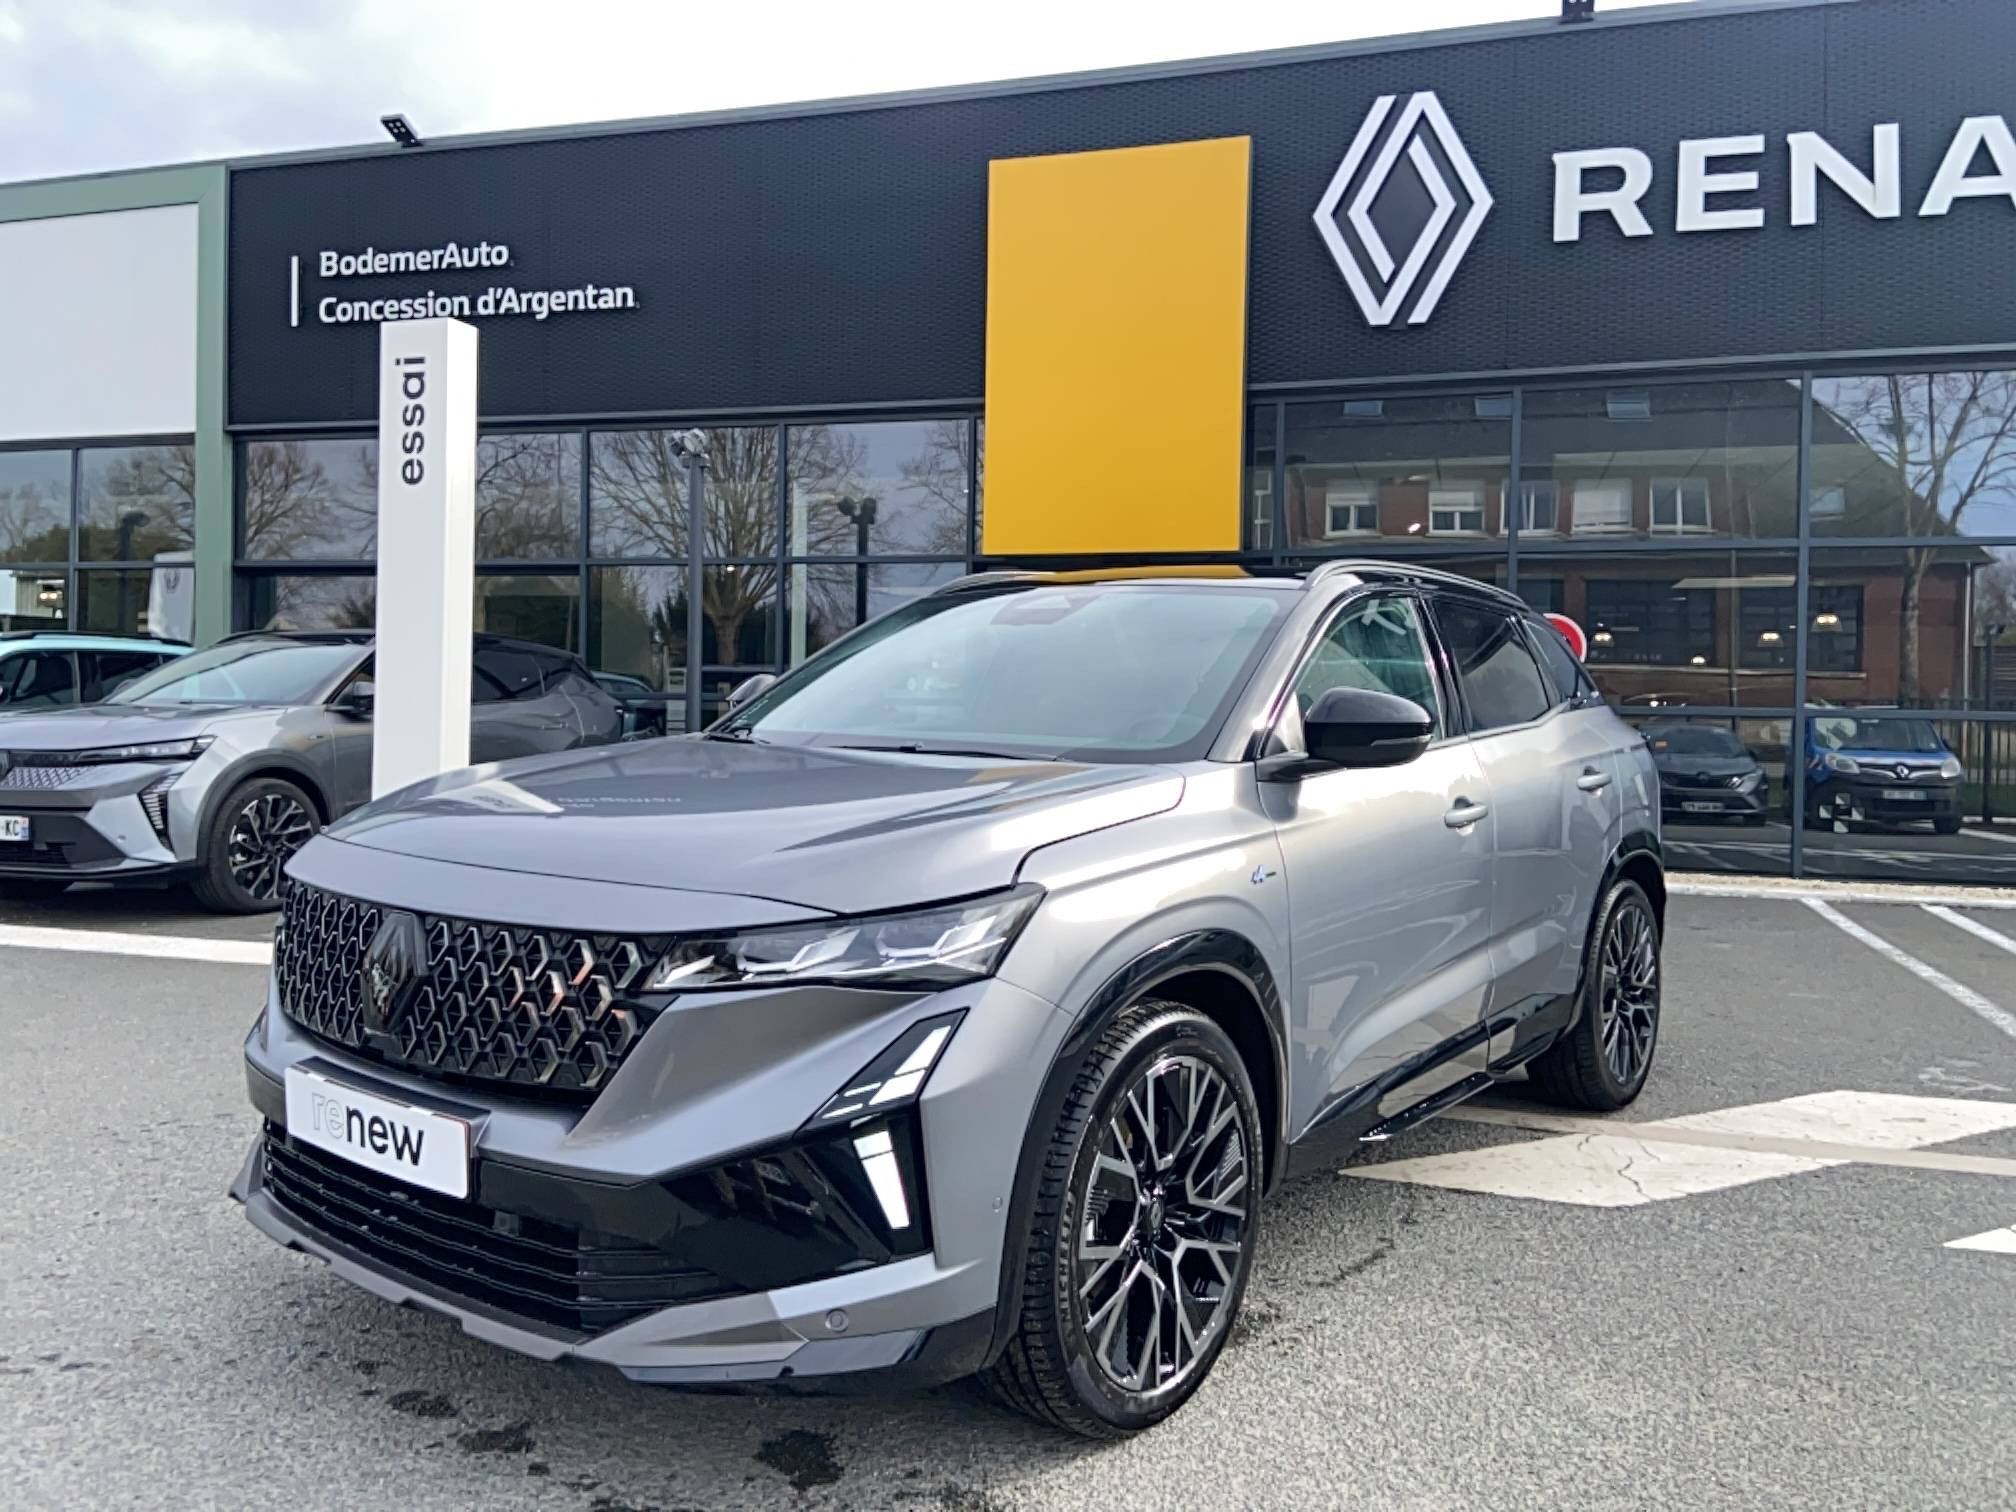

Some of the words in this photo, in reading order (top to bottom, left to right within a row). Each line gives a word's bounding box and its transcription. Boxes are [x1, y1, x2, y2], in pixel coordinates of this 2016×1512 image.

[1552, 115, 2016, 242] RENA
[319, 242, 508, 277] BodemerAuto
[319, 290, 471, 323] Concession
[476, 286, 635, 320] d'Argentan
[395, 357, 425, 485] essai
[312, 1093, 424, 1166] renew
